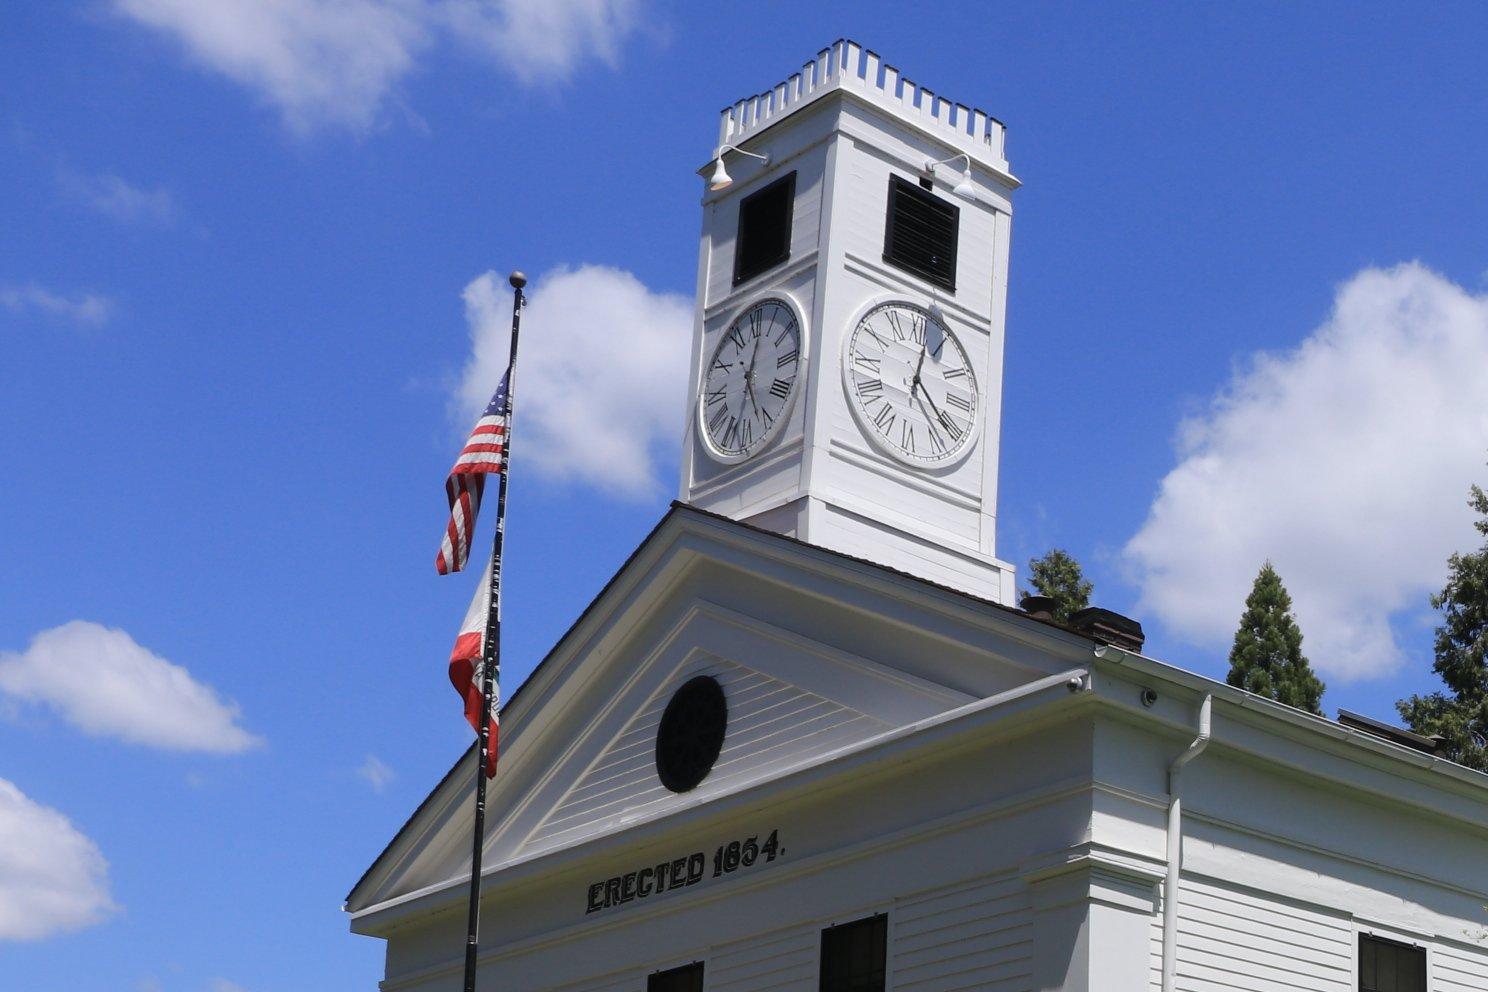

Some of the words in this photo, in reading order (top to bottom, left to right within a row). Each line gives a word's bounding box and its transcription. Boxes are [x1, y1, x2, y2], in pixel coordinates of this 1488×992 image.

[766, 307, 779, 337] I
[774, 321, 794, 348] II
[885, 310, 905, 342] XI
[909, 313, 927, 346] XII
[864, 322, 889, 353] X
[931, 337, 947, 357] I
[715, 359, 734, 375] X
[777, 350, 798, 369] III
[855, 350, 881, 373] IX
[943, 368, 967, 380] II
[946, 392, 970, 412] III
[585, 851, 705, 915] ERECTED
